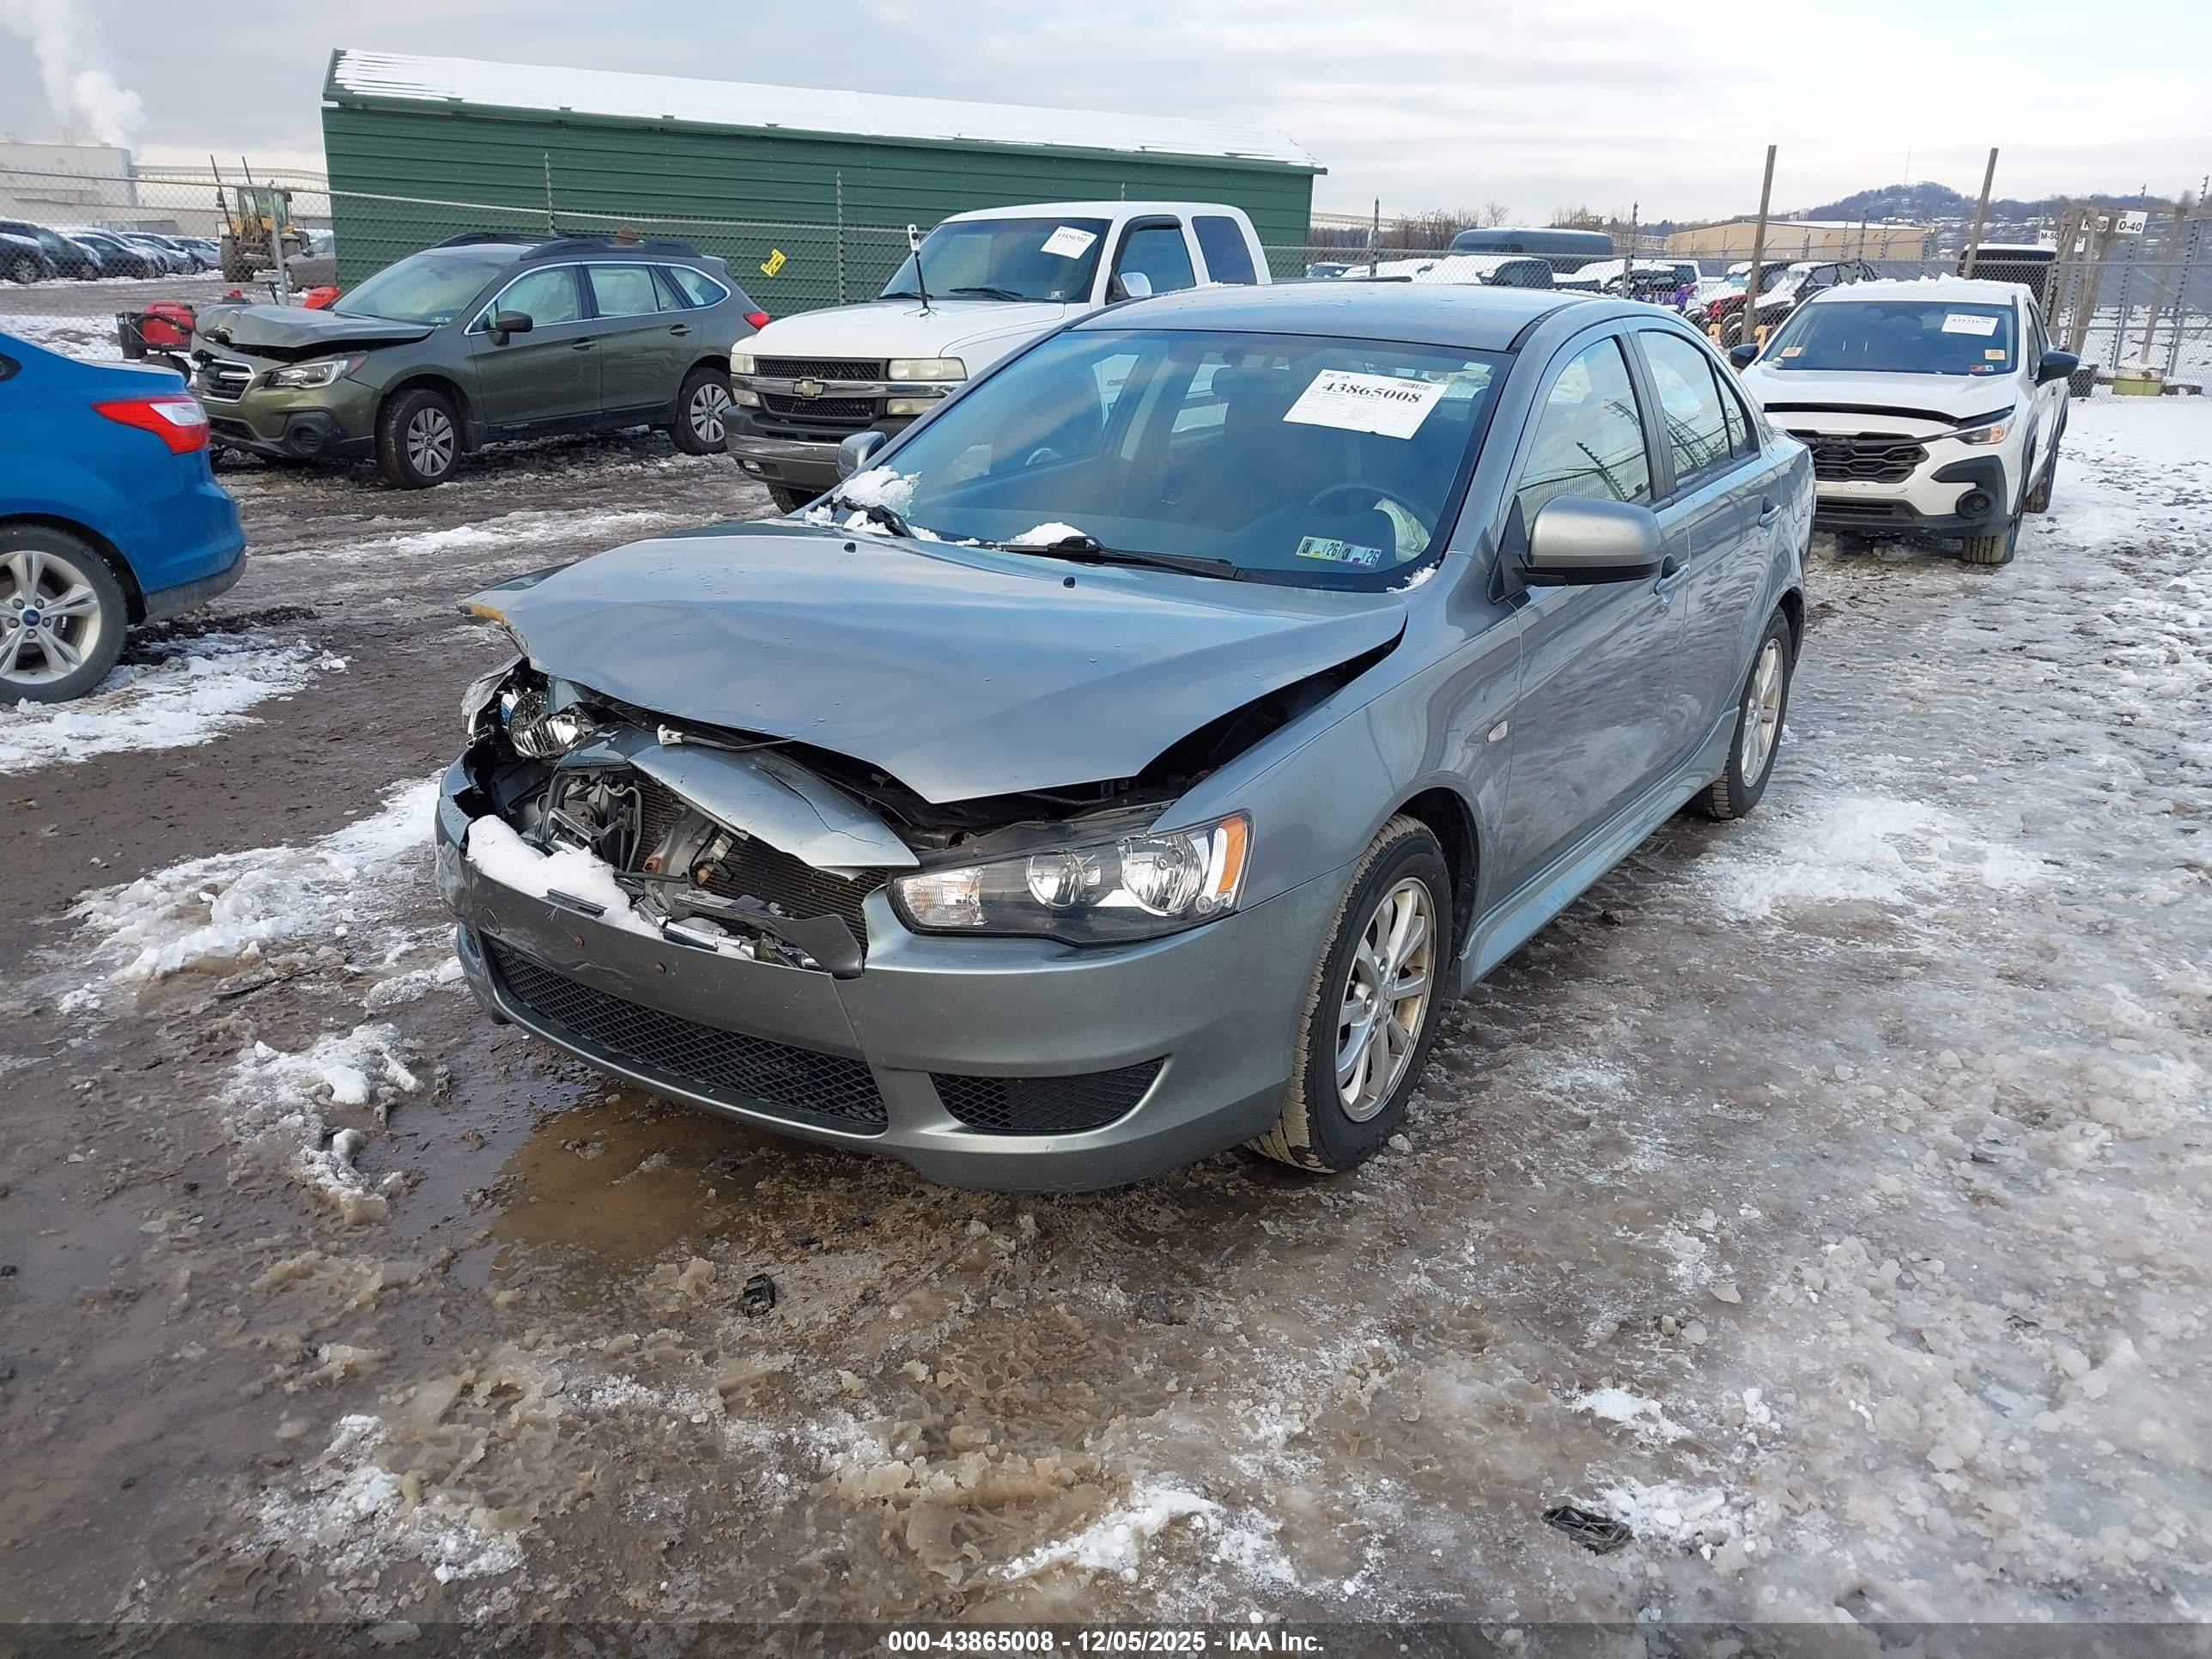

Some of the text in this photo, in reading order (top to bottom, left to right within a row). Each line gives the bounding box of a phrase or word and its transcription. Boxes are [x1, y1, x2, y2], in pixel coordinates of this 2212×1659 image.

[2118, 221, 2142, 232] O-40
[2040, 232, 2060, 240] M-50
[1322, 382, 1423, 404] 43865008
[1303, 542, 1340, 557] 3 26
[1341, 548, 1380, 564] 3 26
